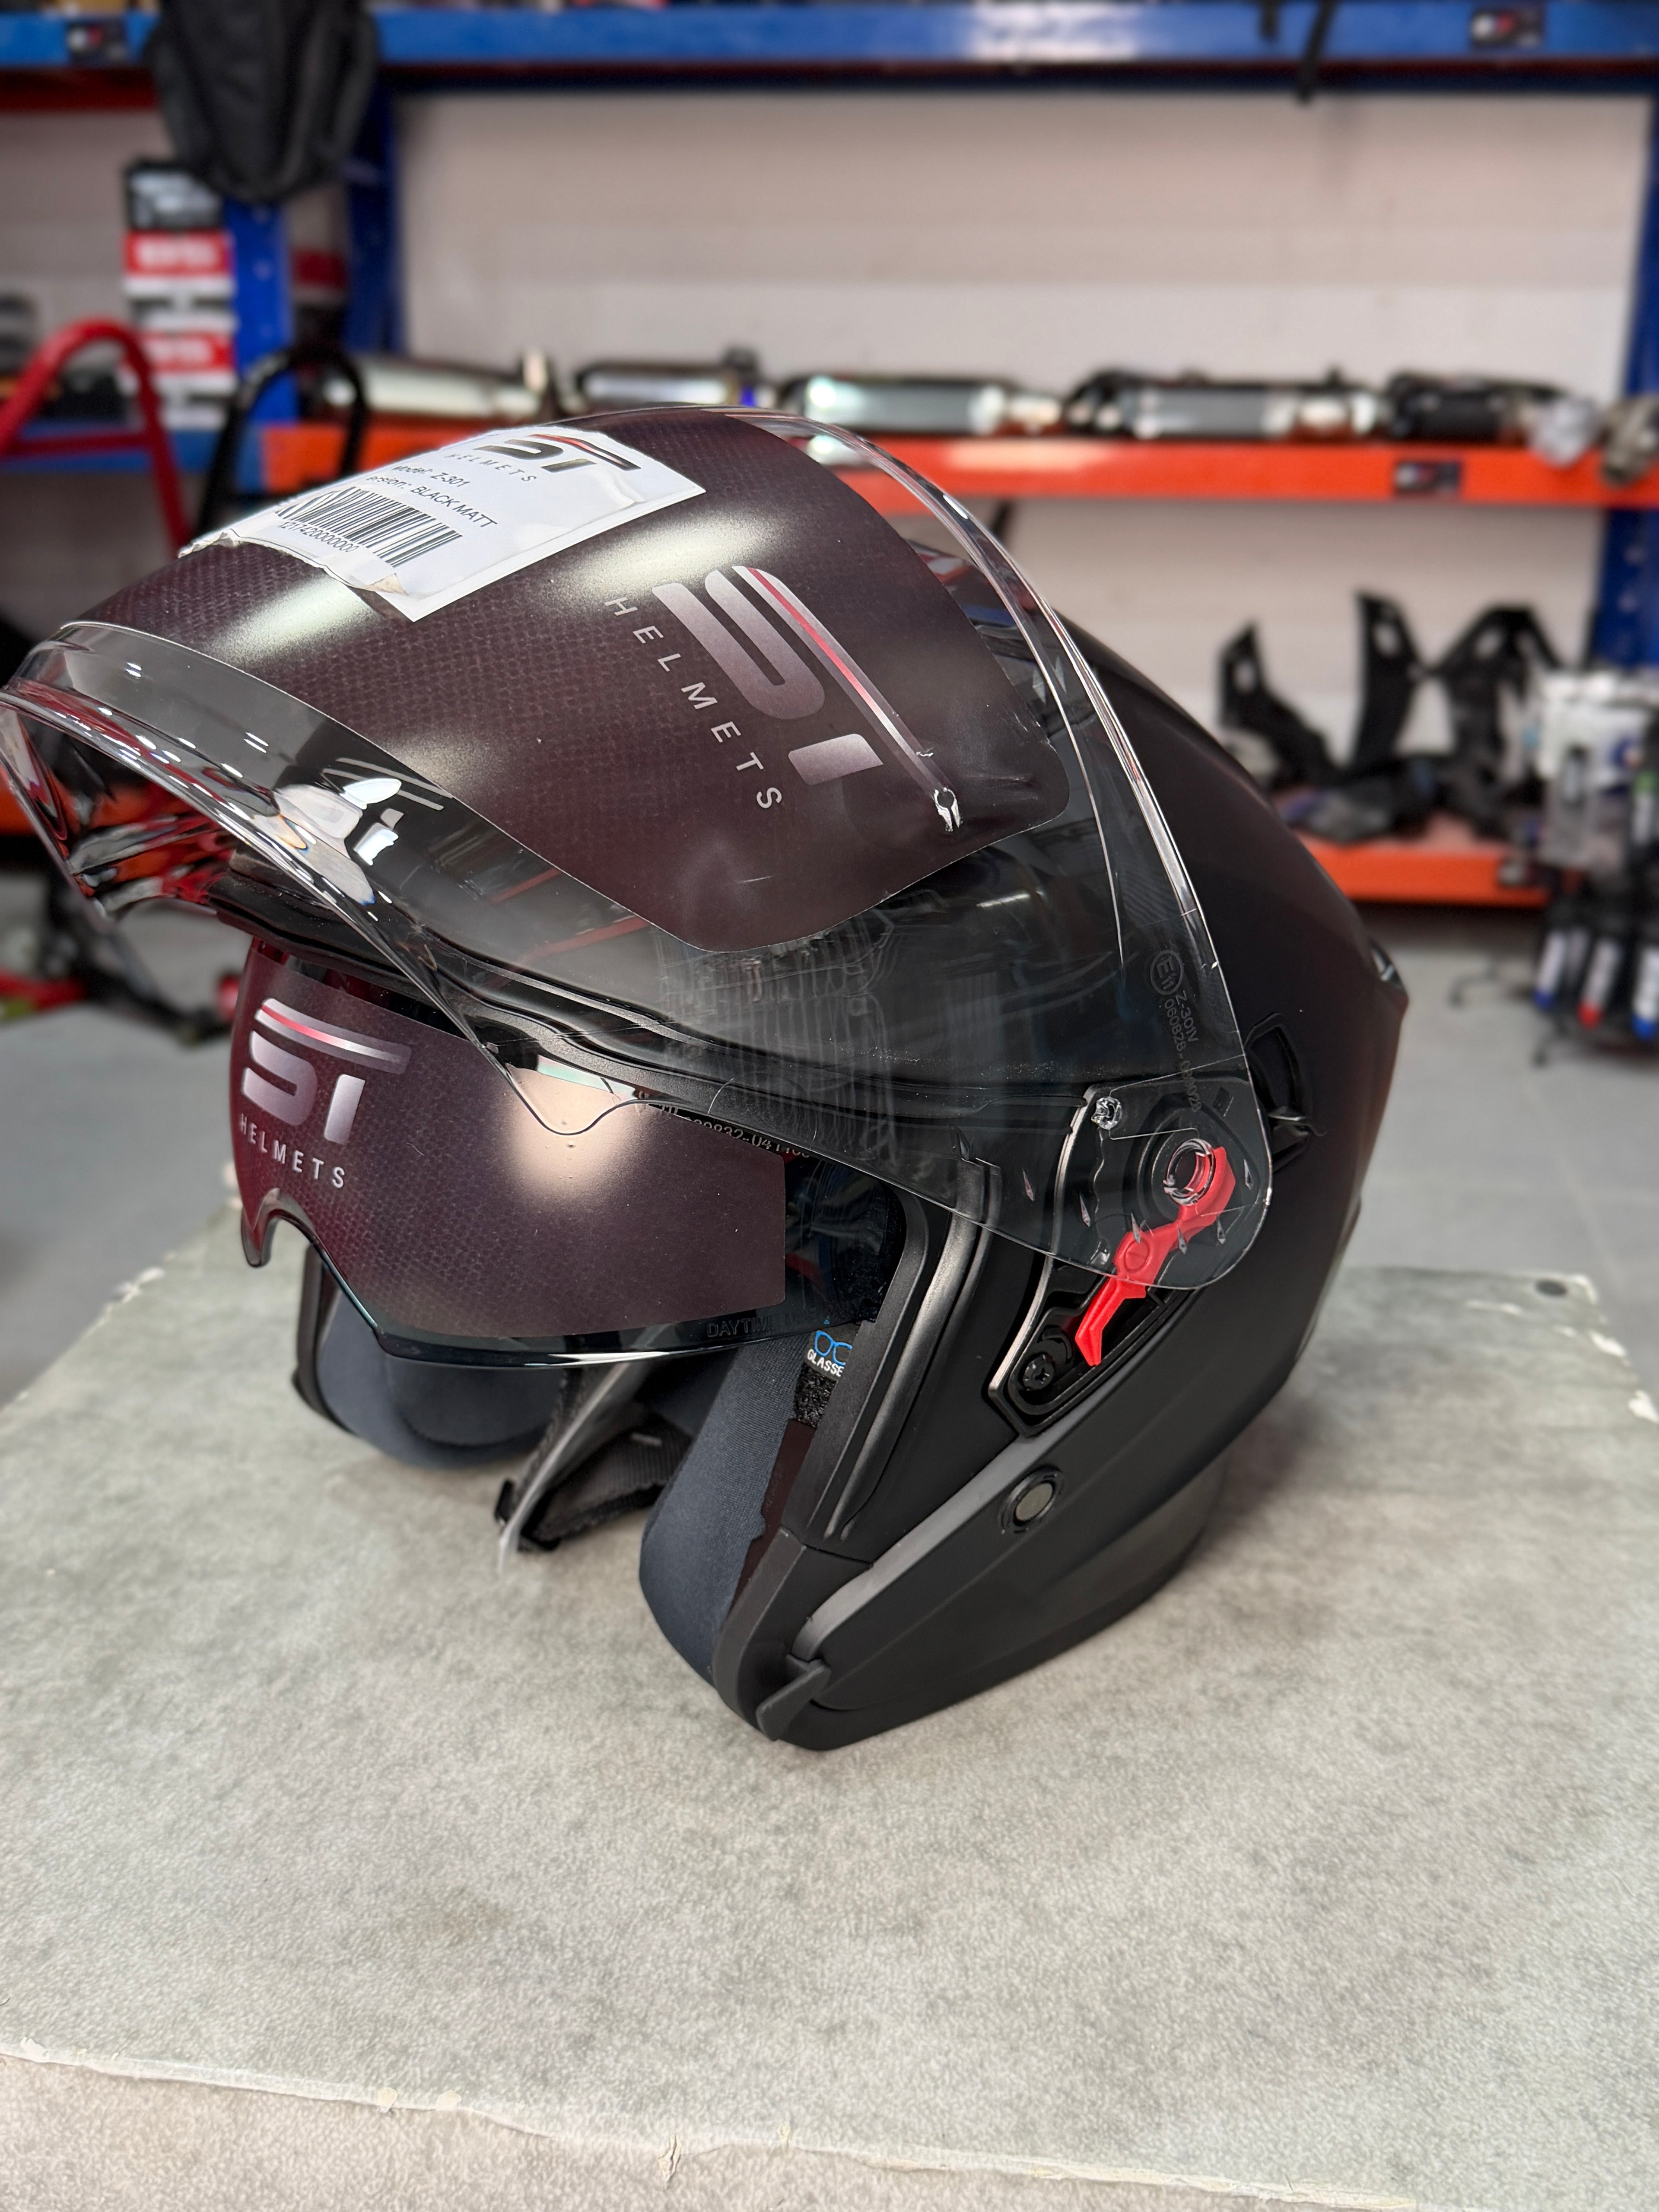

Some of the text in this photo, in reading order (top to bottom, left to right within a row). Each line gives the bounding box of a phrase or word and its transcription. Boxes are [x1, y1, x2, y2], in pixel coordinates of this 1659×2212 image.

[431, 472, 470, 487] Z-301
[445, 454, 537, 482] HELMETS
[410, 486, 460, 507] BLACK
[452, 504, 498, 527] MATT
[605, 597, 782, 809] HELMETS
[240, 1113, 345, 1189] HELMETS
[707, 1315, 779, 1338] DAYTIM
[807, 1348, 844, 1377] GLASSE
